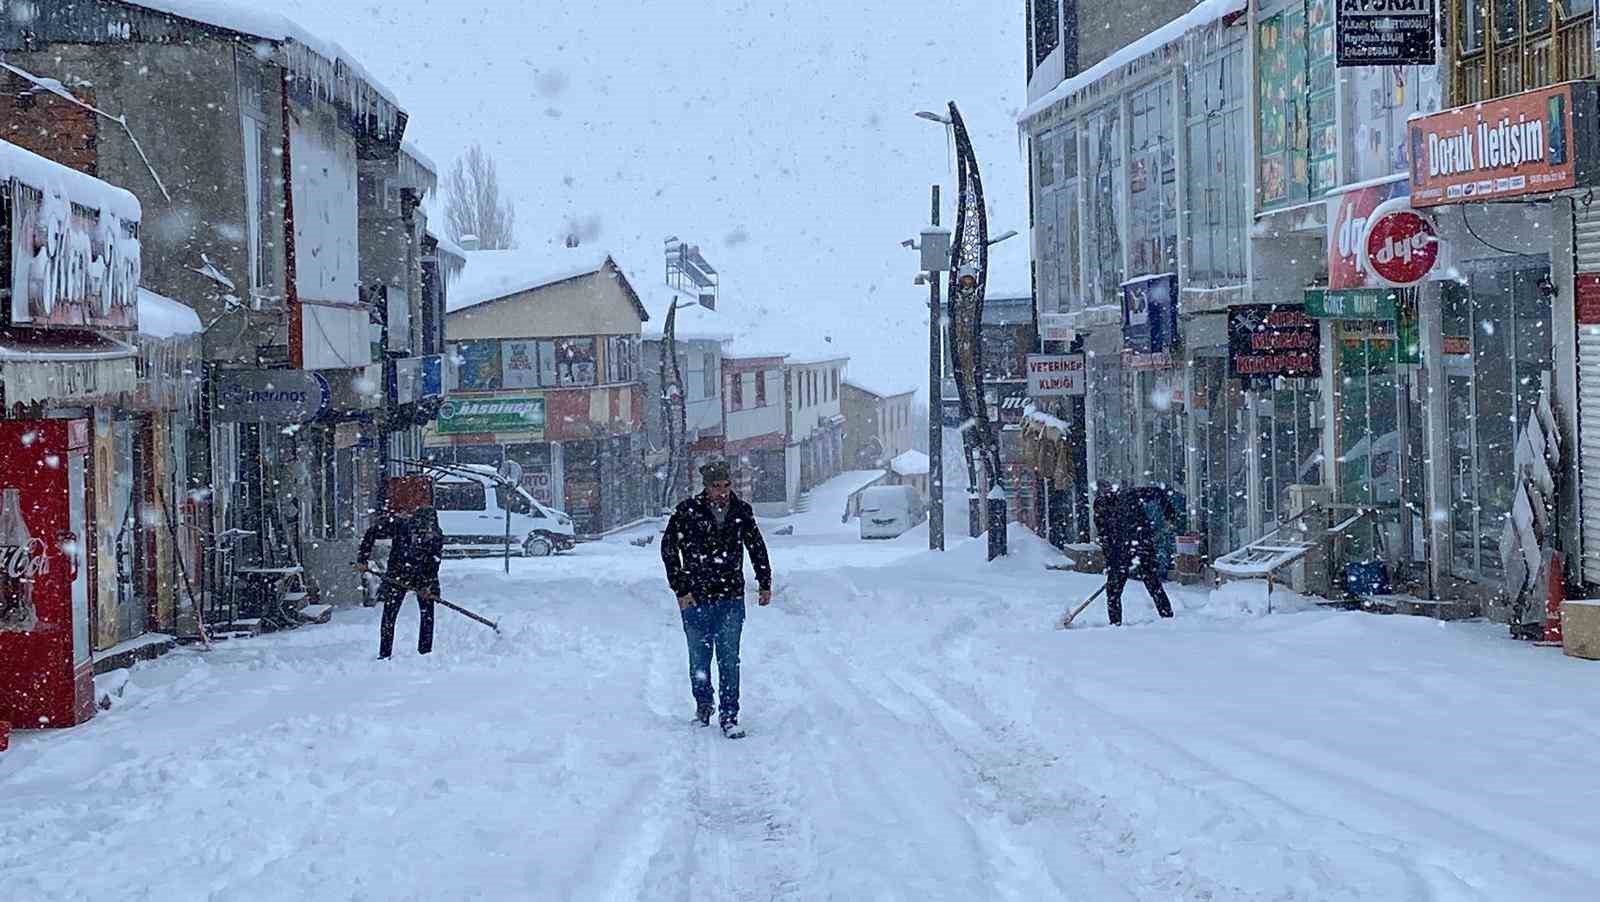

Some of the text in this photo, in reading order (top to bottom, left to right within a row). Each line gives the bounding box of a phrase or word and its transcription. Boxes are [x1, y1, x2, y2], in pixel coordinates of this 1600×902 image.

[1428, 114, 1544, 177] Doruk İletişim
[1375, 231, 1429, 265] dyo
[1030, 358, 1083, 373] VETERİNER
